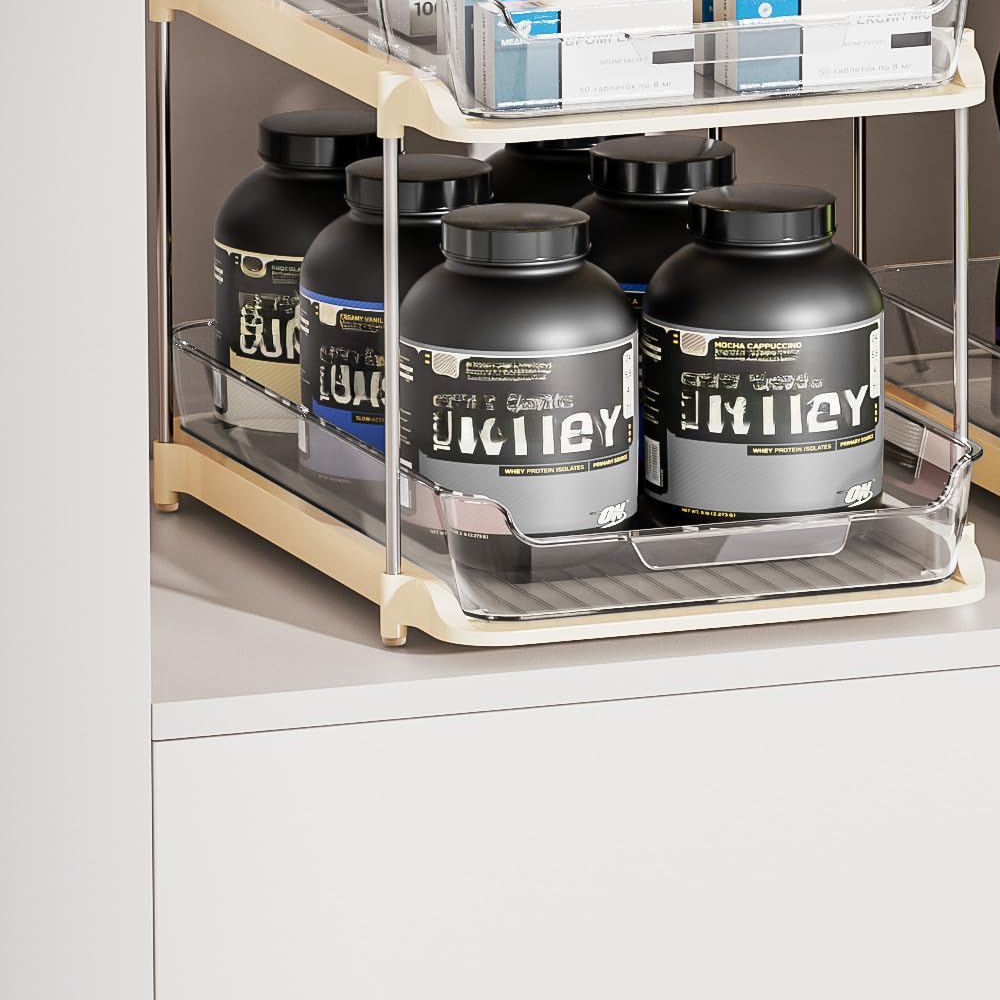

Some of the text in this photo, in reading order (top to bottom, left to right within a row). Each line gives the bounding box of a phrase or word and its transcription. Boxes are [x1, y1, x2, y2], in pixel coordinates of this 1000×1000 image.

[414, 1, 437, 17] 10
[714, 341, 802, 350] MOCHA CAPPUCCINO
[752, 443, 832, 455] WHEY PROTEIN ISOLATES
[504, 467, 525, 475] WHEY
[526, 467, 555, 475] PROTEIN
